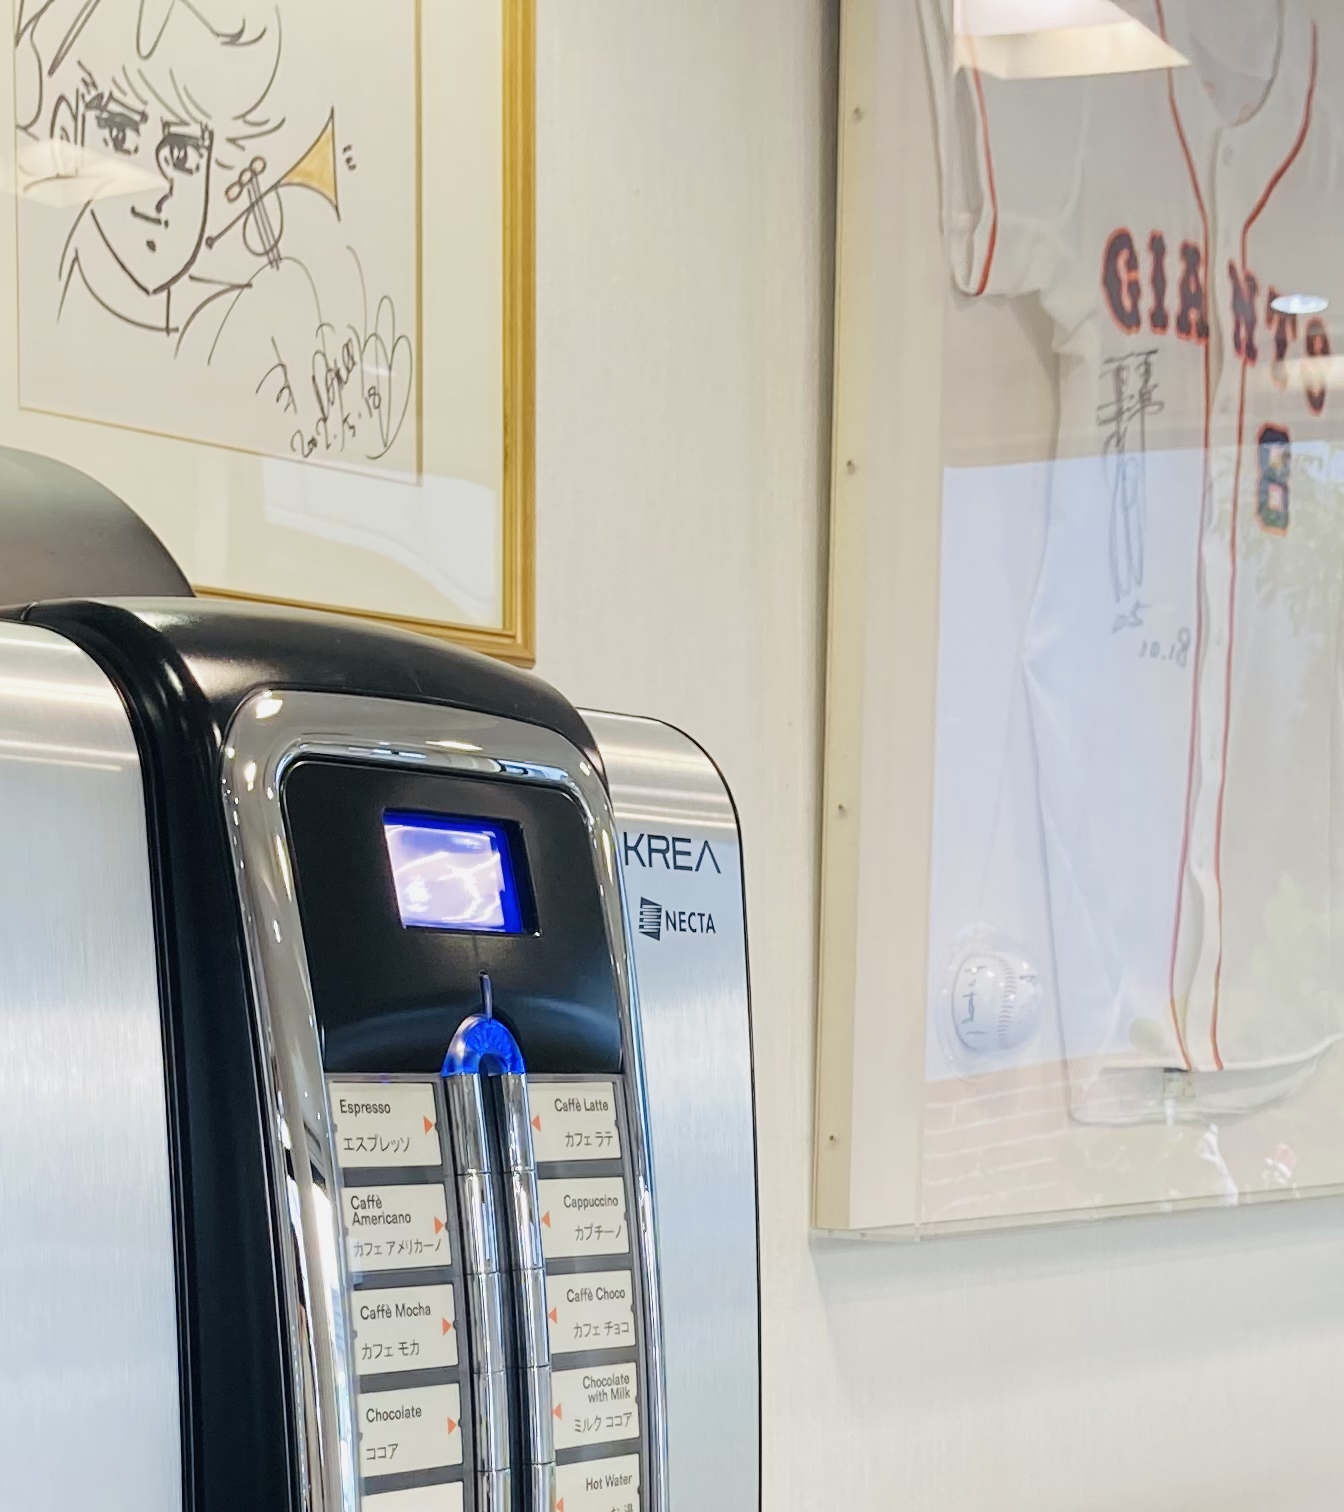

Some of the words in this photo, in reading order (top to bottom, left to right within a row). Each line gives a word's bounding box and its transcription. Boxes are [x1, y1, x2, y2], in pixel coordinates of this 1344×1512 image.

[665, 909, 717, 935] NECTA
[339, 1099, 392, 1117] Espresso
[554, 1098, 582, 1113] Caffè
[584, 1098, 610, 1113] Latte
[342, 1134, 411, 1154] エスプレッソ
[350, 1194, 383, 1211] Caffè
[563, 1194, 620, 1213] Cappuccino
[351, 1211, 413, 1228] Americano
[574, 1223, 624, 1242] カプチーノ
[566, 1287, 595, 1303] Caffè
[596, 1286, 626, 1301] Choco
[360, 1304, 392, 1321] Caffè
[395, 1301, 432, 1318] Mocha
[582, 1373, 631, 1390] Chocolate
[587, 1388, 609, 1404] with
[611, 1386, 631, 1402] Milk
[365, 1404, 422, 1423] Chocolate
[365, 1442, 399, 1462] ココア
[585, 1475, 604, 1492] Hot
[605, 1472, 633, 1489] Water
